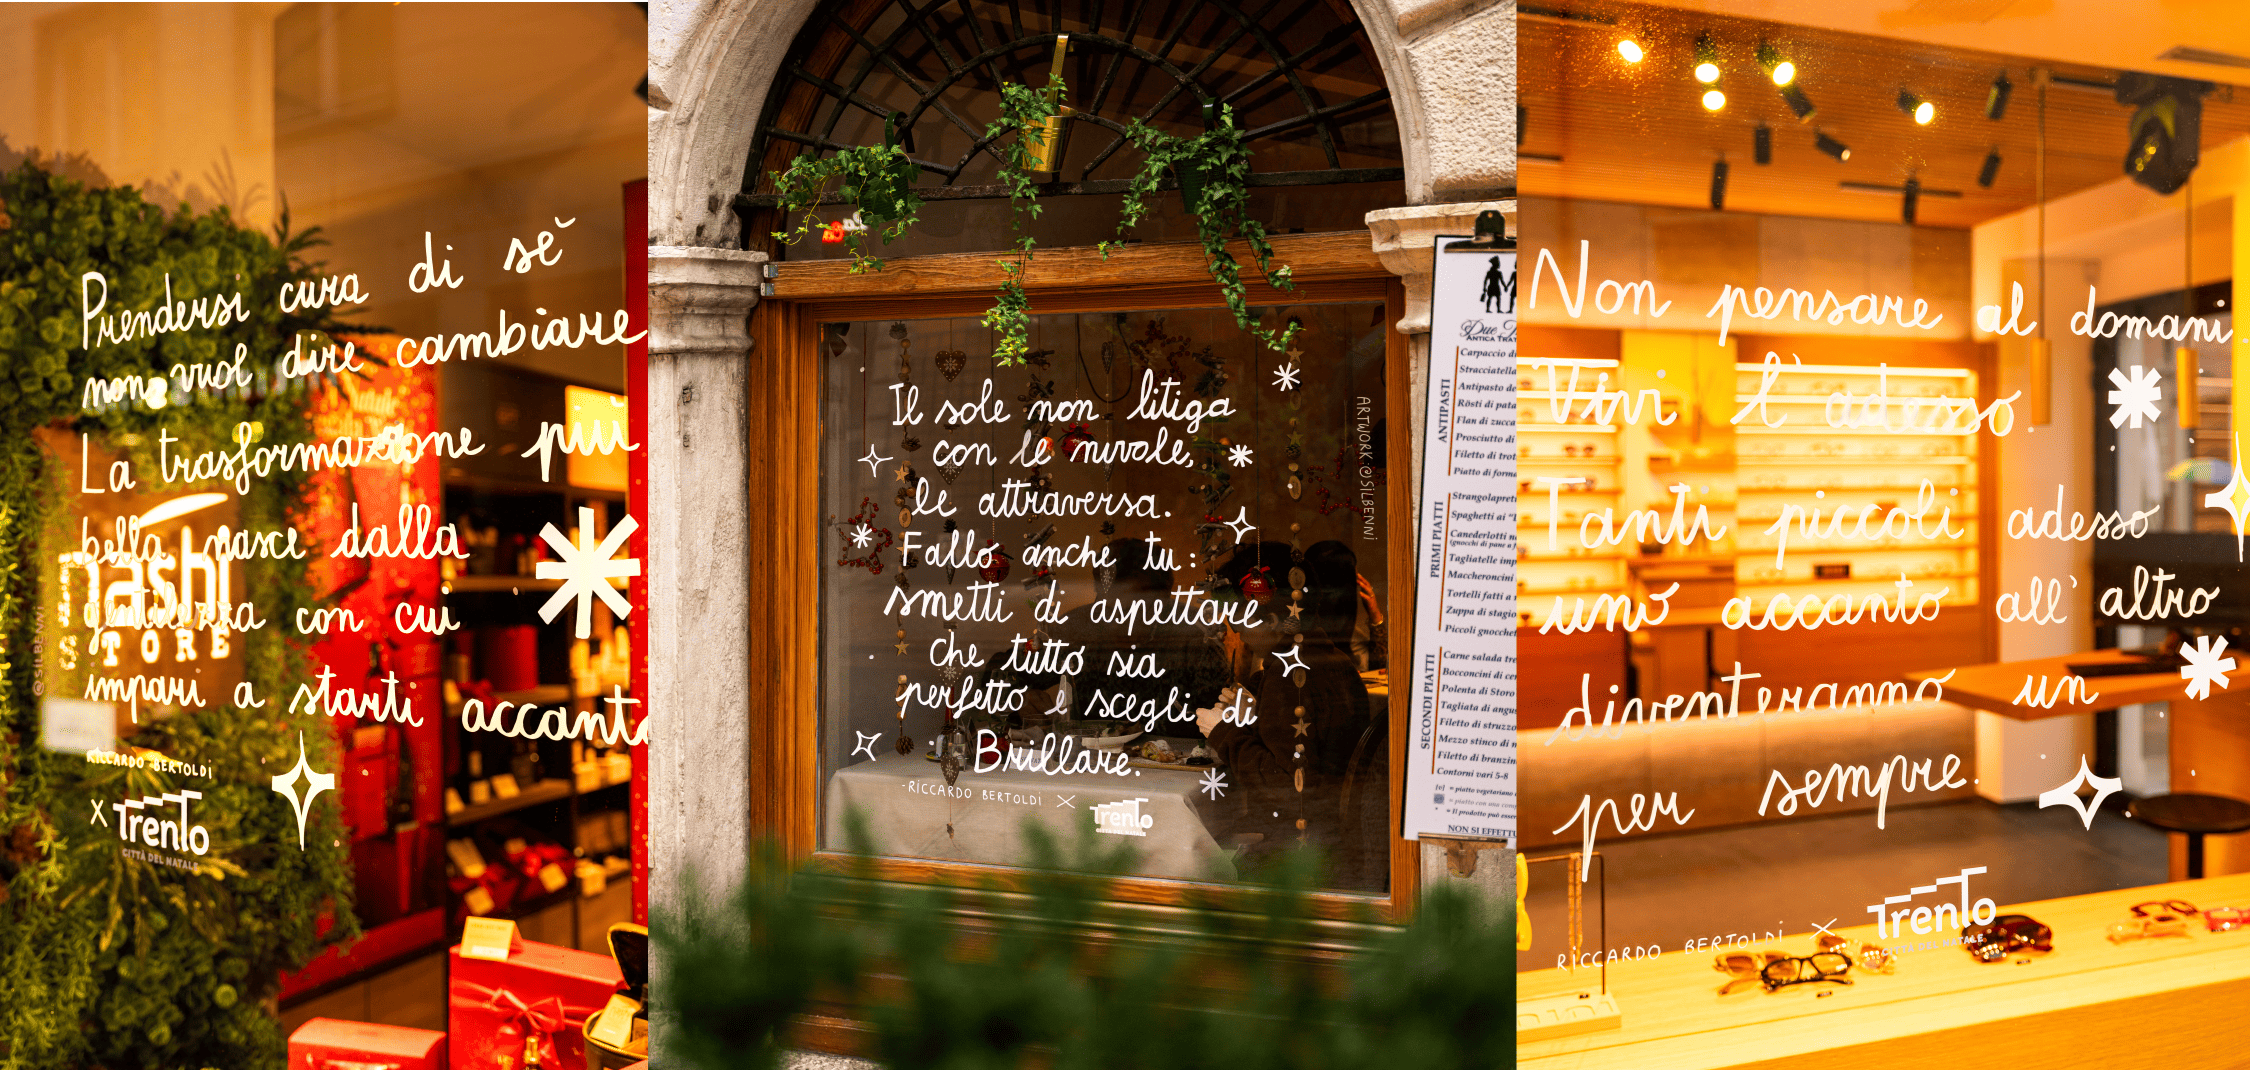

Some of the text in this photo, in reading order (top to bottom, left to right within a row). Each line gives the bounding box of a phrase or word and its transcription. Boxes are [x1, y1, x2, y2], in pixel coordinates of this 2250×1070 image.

[82, 271, 250, 350] Prendersi
[280, 272, 369, 314] cura
[409, 231, 464, 293] di
[1530, 240, 1672, 318] Non
[1706, 282, 1943, 347] pensare
[1976, 281, 2038, 337] al
[1460, 319, 1498, 337] Due
[82, 307, 648, 408] non vuol dire cambiare
[1460, 348, 1506, 359] Carpaccio
[1460, 365, 1517, 375] Stracciatella
[889, 368, 1236, 434] Il sole non litiga
[1458, 382, 1504, 393] Antipasto
[1532, 351, 2034, 437] Vivi l' adesso.
[1438, 379, 1451, 443] ANTIPASTI
[1457, 399, 1517, 411] Rösti di pata
[1456, 416, 1477, 424] Flan
[1479, 417, 1489, 425] di
[82, 433, 136, 494] La
[160, 421, 485, 495] trasformazione
[522, 397, 640, 482] più
[932, 426, 1195, 468] con le nuvole,
[1456, 433, 1516, 443] Prosciutto di
[1454, 450, 1497, 459] Filetto di
[1454, 467, 1492, 476] Piatto di
[911, 476, 1172, 519] le attraversa.
[1451, 510, 1495, 521] Spaghetti
[1496, 512, 1506, 521] ai
[1537, 476, 2161, 570] Tanti piccoli adesso
[82, 503, 470, 566] bella nasce dalla
[1430, 501, 1444, 578] PRIMI PIATTI
[1450, 529, 1507, 541] Canederlotti
[902, 530, 999, 568] Fallo
[1022, 530, 1116, 569] anche
[1449, 554, 1498, 564] Tagliatelle
[58, 525, 230, 627] nashi
[1448, 570, 1514, 582] Maccheroncini
[883, 578, 1263, 636] smetti di aspettare
[1447, 589, 1481, 599] Tortelli
[1481, 591, 1504, 601] fatti
[1538, 565, 2221, 636] uno accanto all' altro
[84, 581, 461, 656] gentilezza con cui
[1446, 606, 1517, 620] Zuppa di stagio
[1445, 624, 1477, 634] Piccoli
[58, 625, 231, 670] STORE
[929, 629, 1166, 679] che tutto sia
[1443, 650, 1470, 660] Carne
[1472, 653, 1502, 662] salada
[1442, 667, 1504, 679] Bocconcini di
[84, 664, 206, 723] impari
[234, 681, 266, 709] a
[290, 665, 424, 728] starti
[895, 675, 1258, 733] perfetto e scegli di
[1421, 654, 1436, 750] SECONDI PIATTI
[1441, 684, 1515, 697] Polenta di Storo
[1544, 661, 2099, 746] diventeranno un
[1441, 701, 1491, 712] Tagliata di
[1439, 718, 1517, 731] Filetto di struzzo
[974, 729, 1141, 777] Brillare.
[1438, 735, 1468, 744] Mezzo
[1470, 738, 1498, 746] stinco
[1500, 739, 1510, 748] di
[1437, 751, 1516, 764] Filetto di branzin
[1437, 767, 1475, 777] Contorni
[1495, 772, 1509, 780] 5-8
[1476, 788, 1514, 796] vegetariano
[113, 790, 210, 856] Trento
[1089, 797, 1154, 829] Trento
[1553, 753, 1980, 882] per sempre.
[1448, 824, 1480, 834] NON SI
[122, 847, 199, 871] CITTÀ DEL NATALE
[1867, 866, 1997, 940] Trento
[1881, 933, 1984, 957] CITTÀ DEL NATALE
